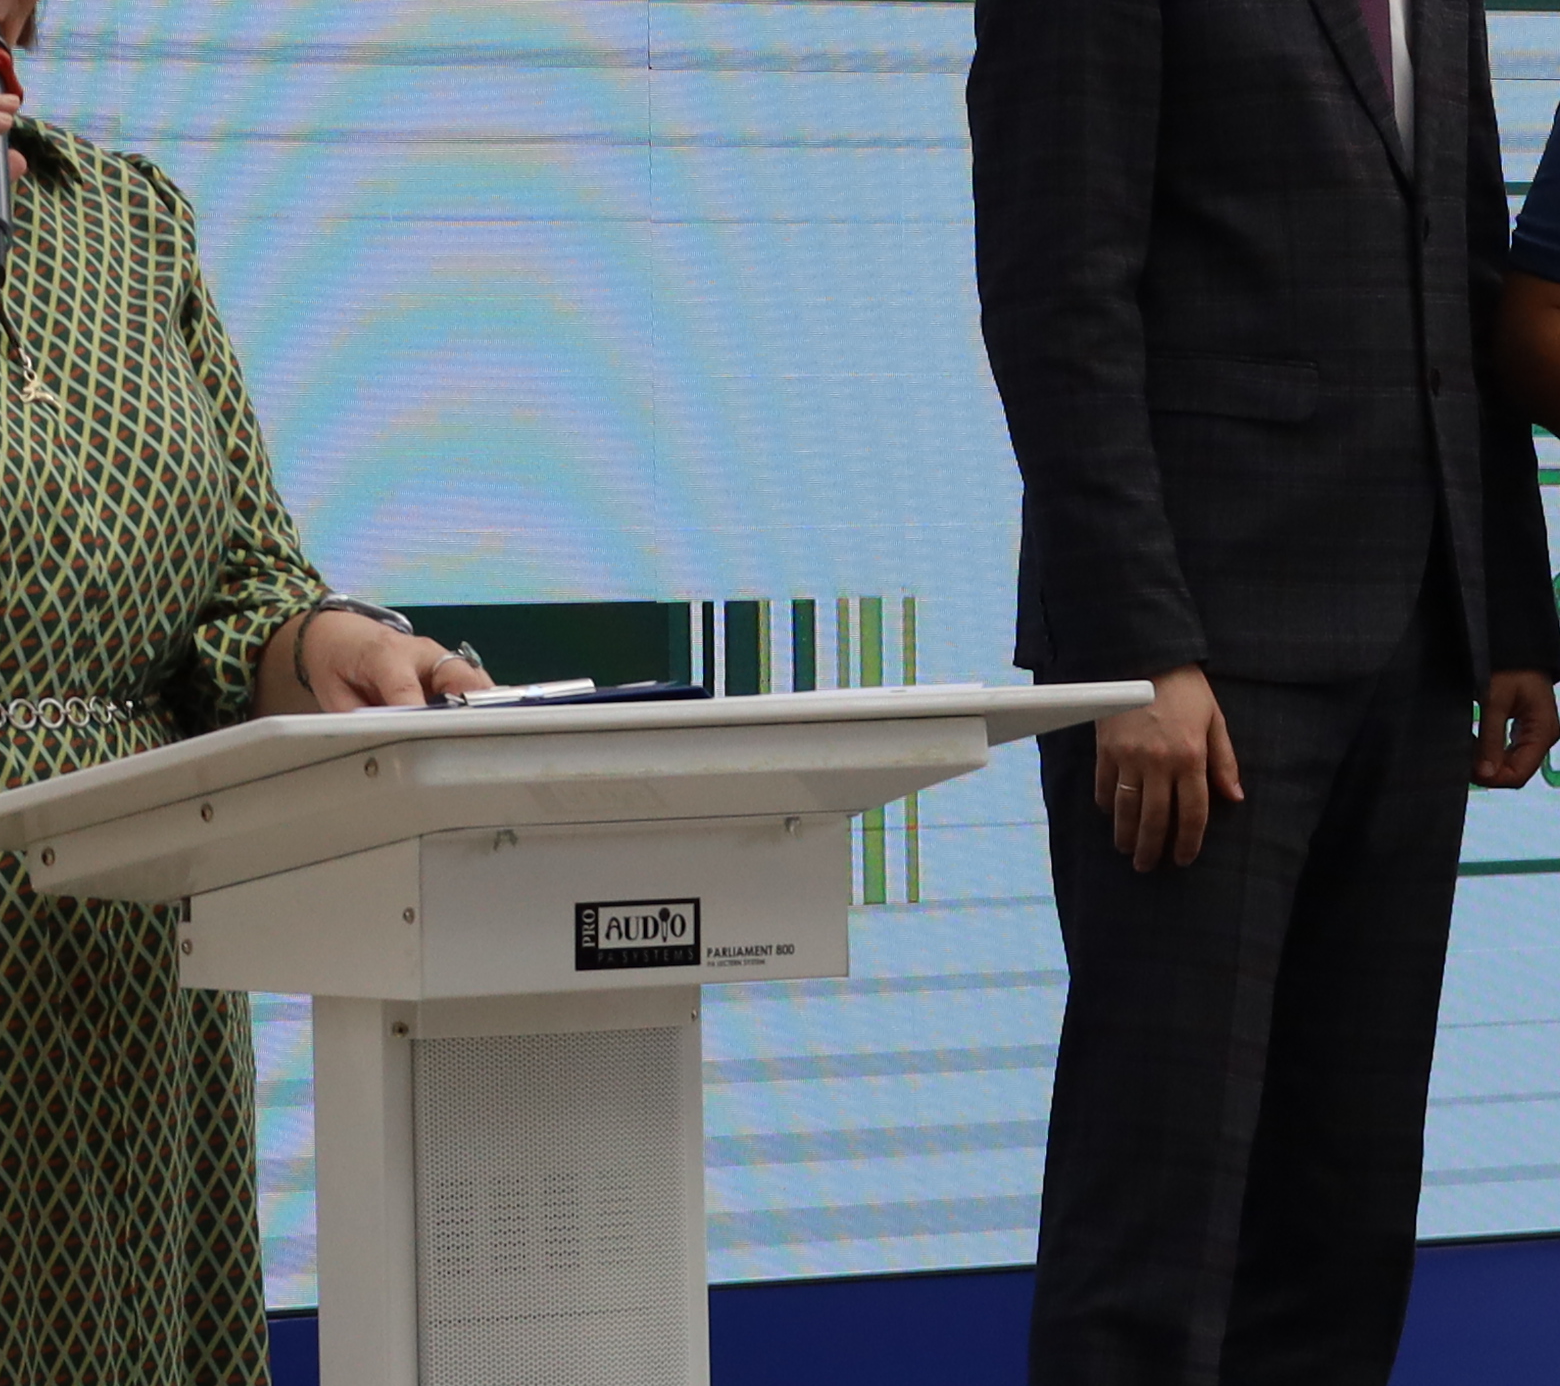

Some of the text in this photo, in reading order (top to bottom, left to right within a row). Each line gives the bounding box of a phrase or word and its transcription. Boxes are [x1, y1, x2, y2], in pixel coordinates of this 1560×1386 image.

[582, 909, 596, 948] PRO
[598, 948, 694, 963] PA SYSTEMS
[707, 944, 795, 958] PARLIAMENT 800
